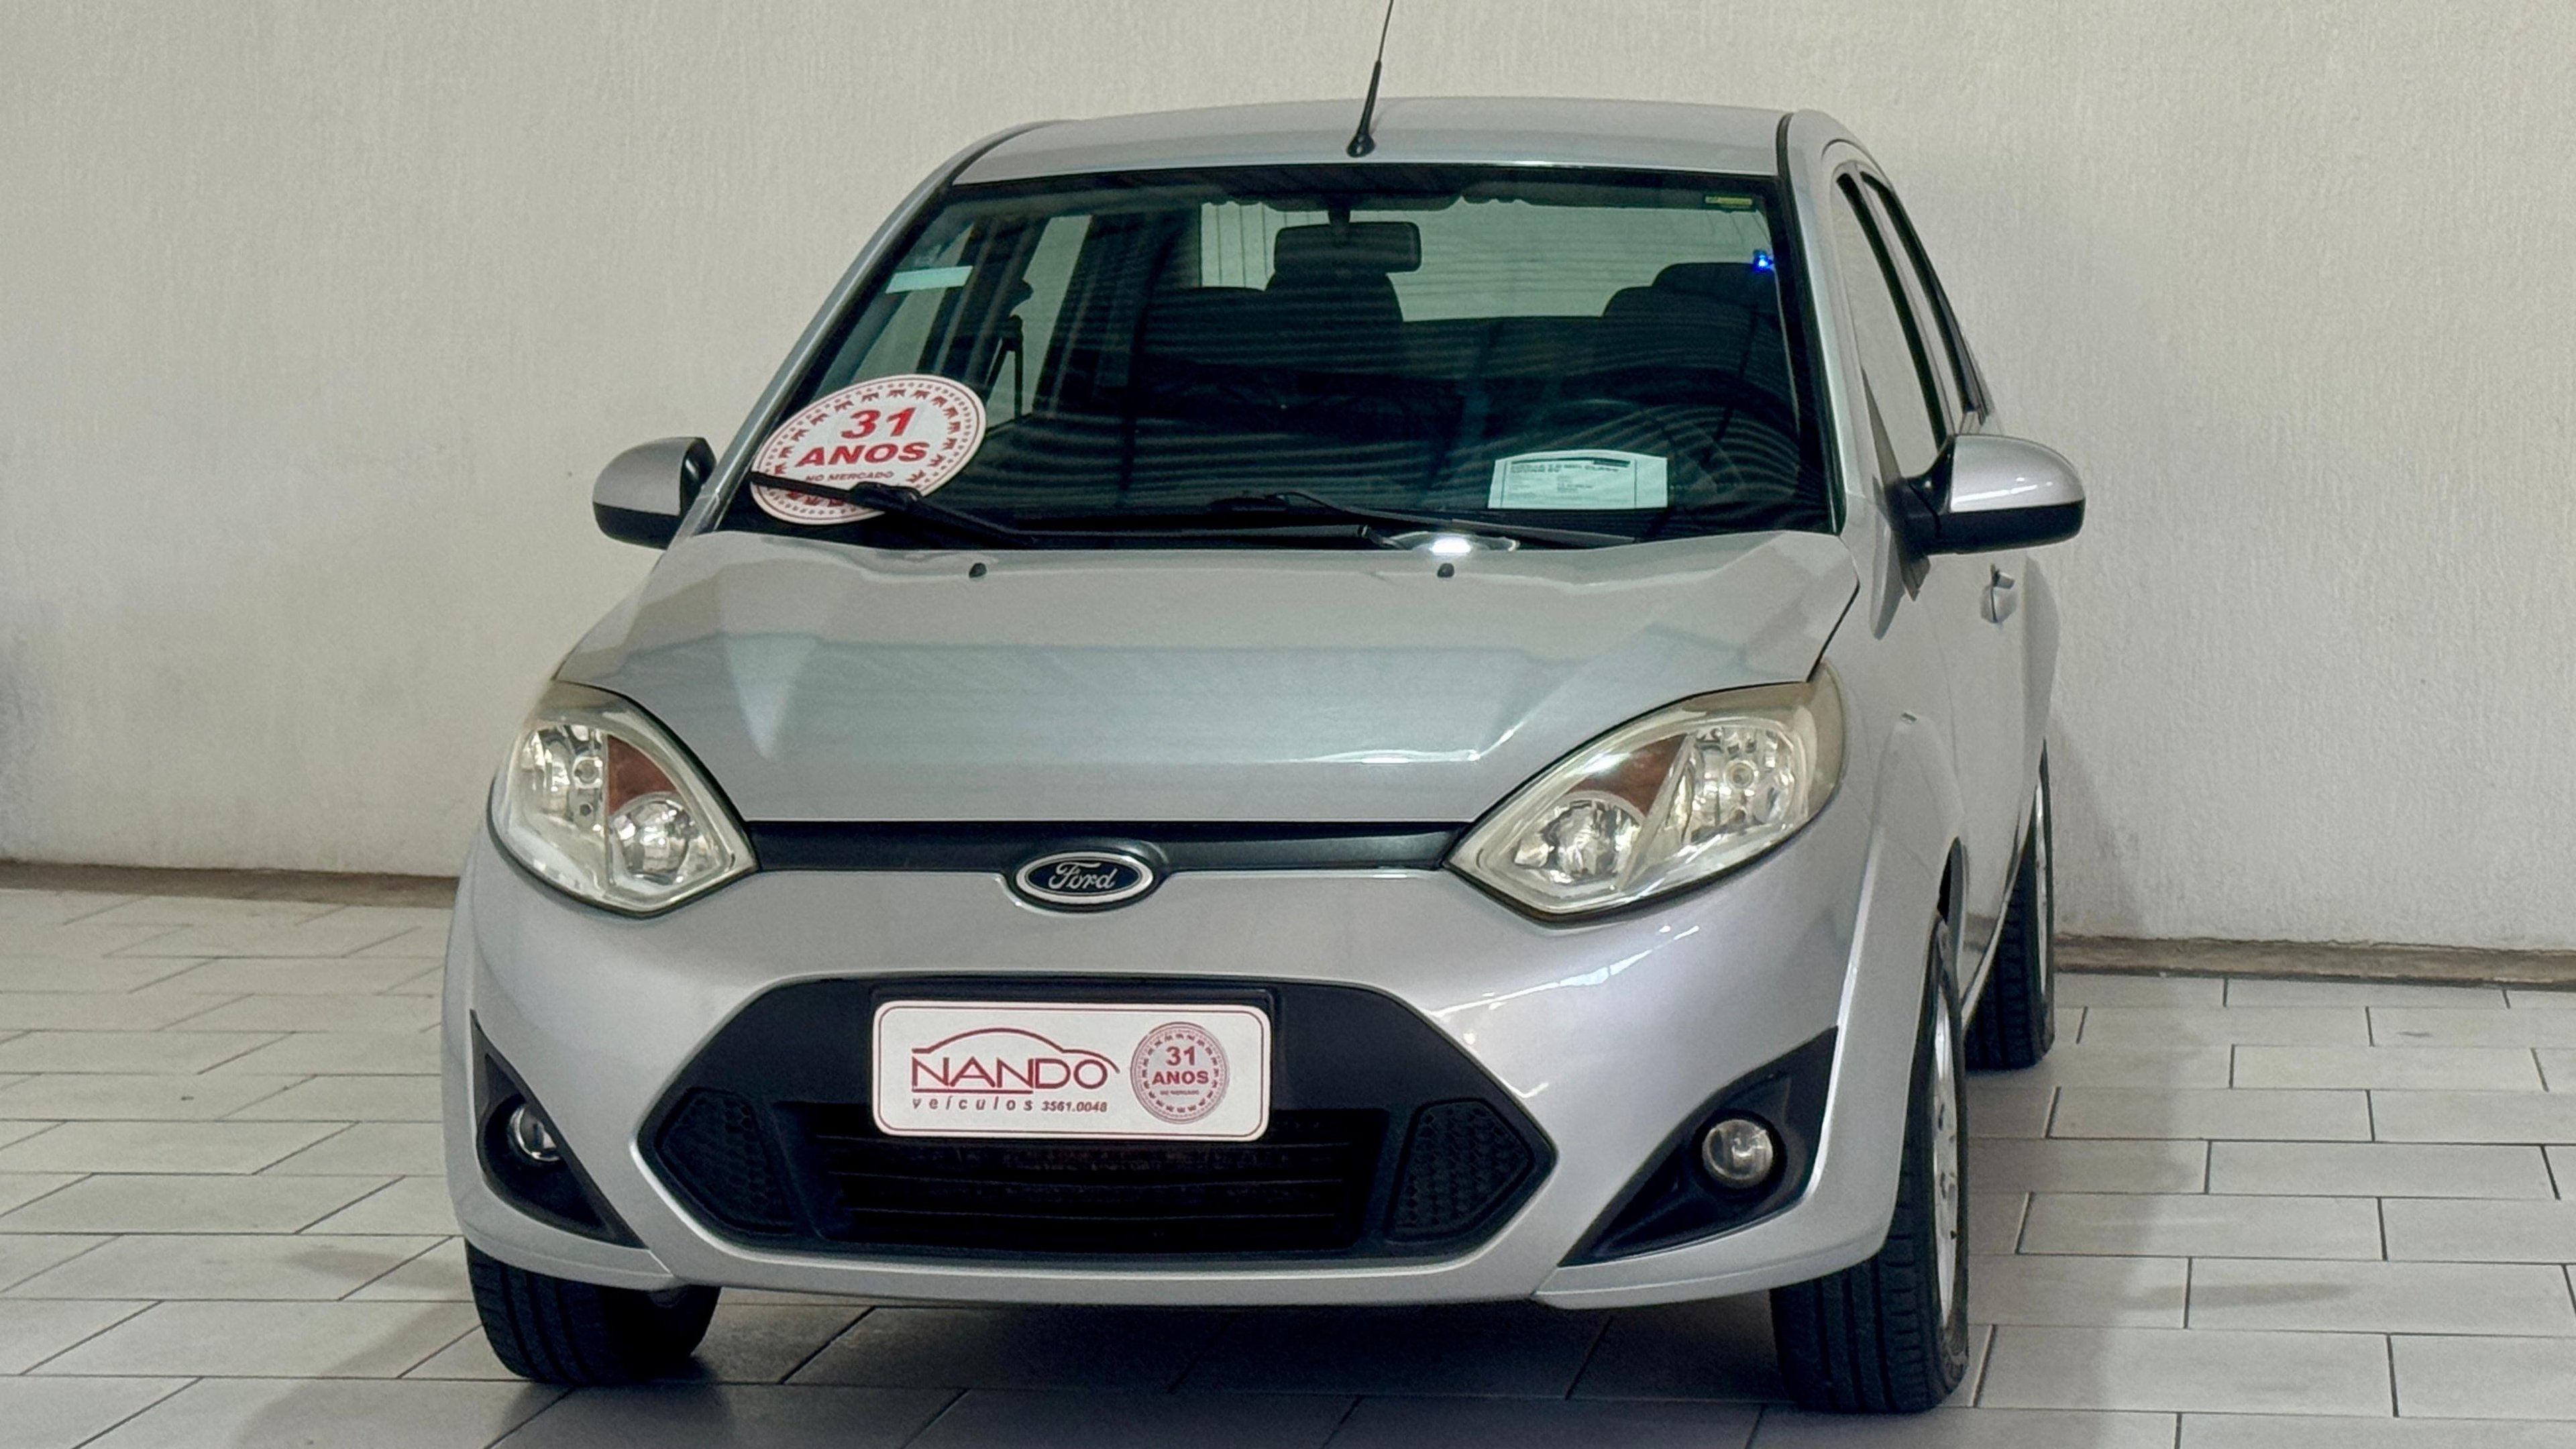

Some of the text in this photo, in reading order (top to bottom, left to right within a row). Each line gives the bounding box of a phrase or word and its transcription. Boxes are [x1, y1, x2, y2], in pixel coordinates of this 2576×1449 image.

[841, 407, 916, 439] 31
[794, 441, 930, 468] ANOS
[806, 470, 895, 482] NO MERCADO
[1048, 861, 1119, 890] Ford
[1166, 1046, 1195, 1066] 31
[912, 1056, 1108, 1089] NANDO
[1151, 1070, 1210, 1085] ANOS
[912, 1095, 1108, 1113] veículos 3561.0048
